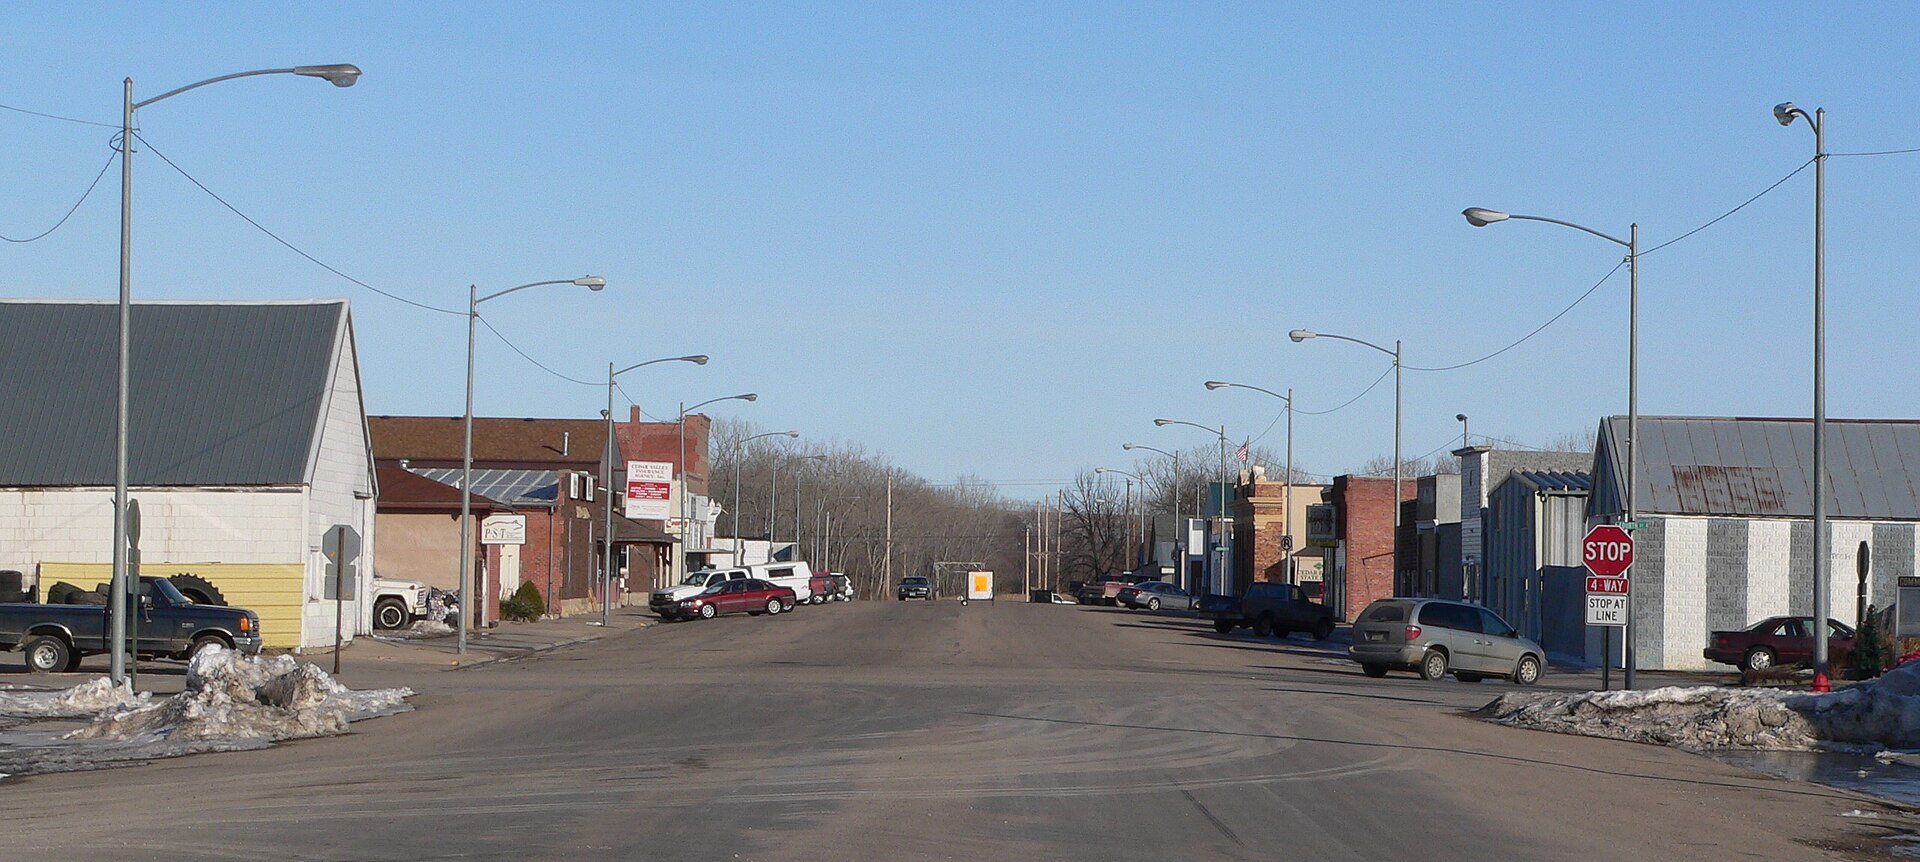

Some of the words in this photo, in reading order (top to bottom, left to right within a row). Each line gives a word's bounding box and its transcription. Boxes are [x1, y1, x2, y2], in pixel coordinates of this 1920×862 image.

[1585, 541, 1631, 561] STOP
[1589, 598, 1613, 609] STOP
[1614, 599, 1625, 609] AT
[1596, 611, 1618, 622] LINE
